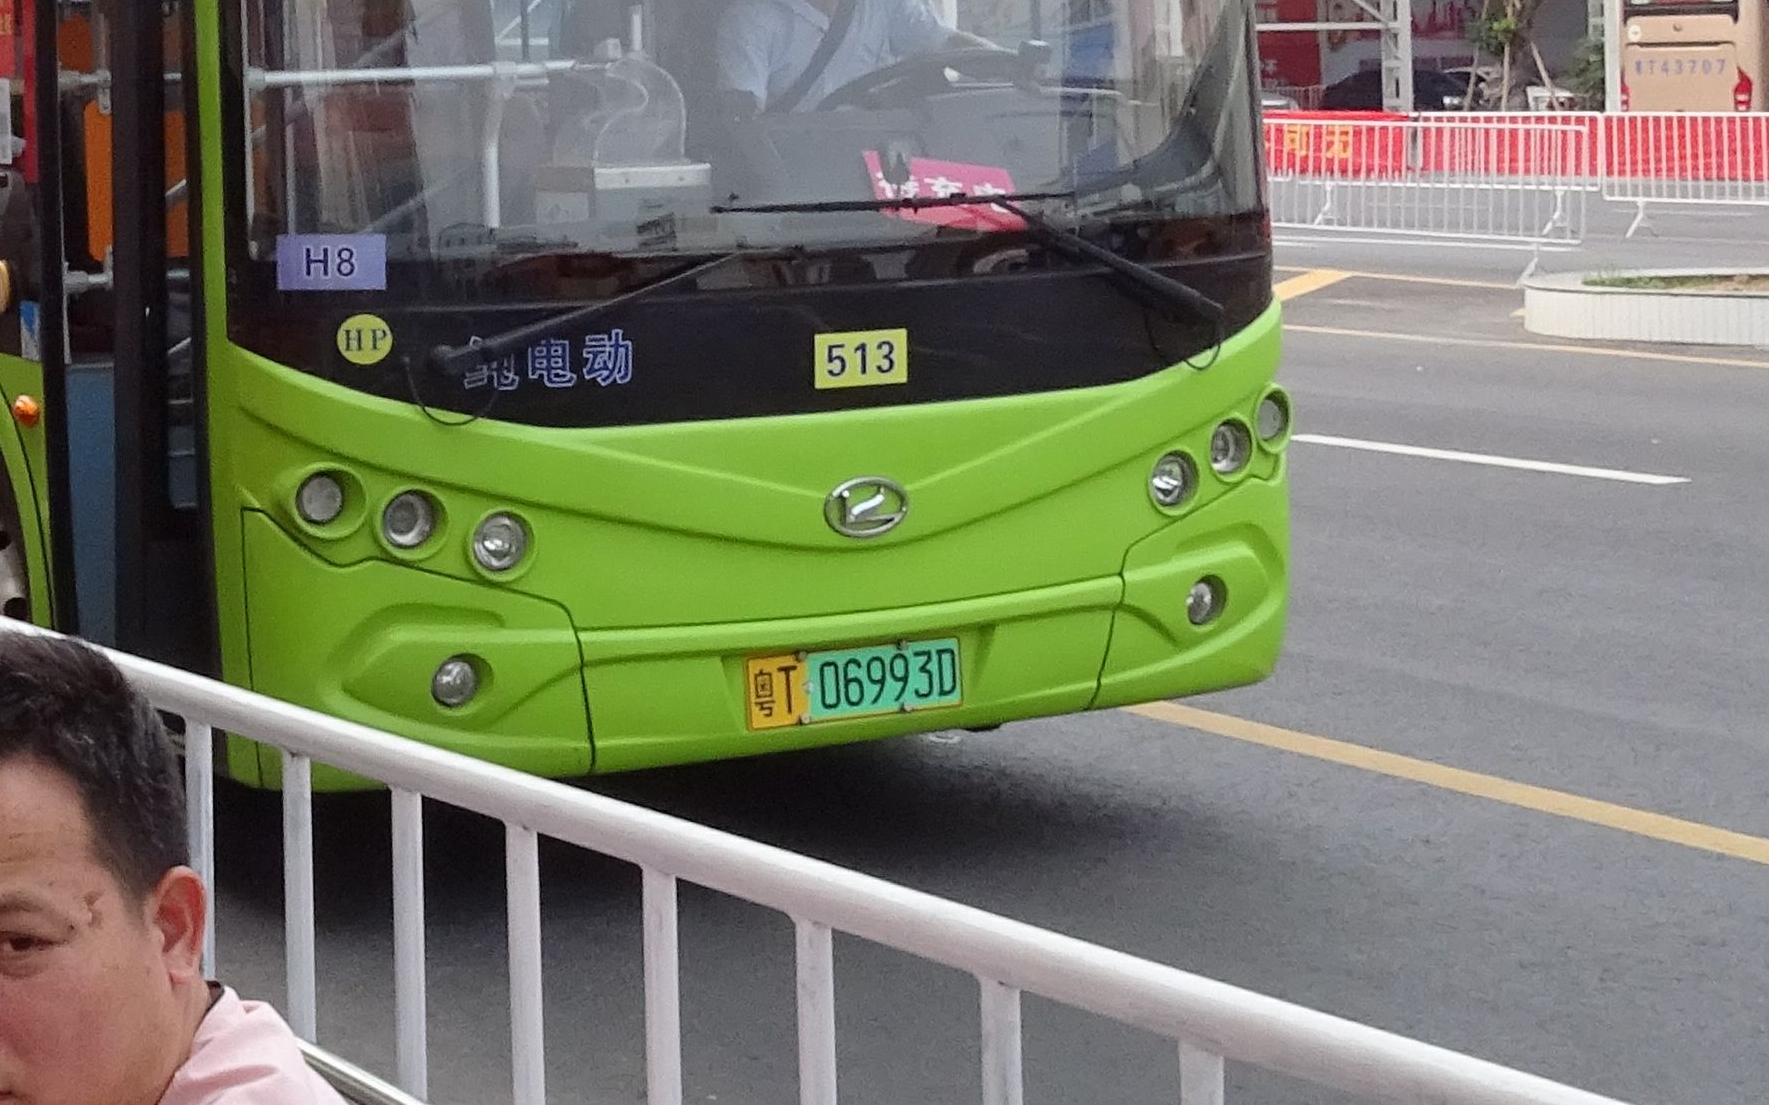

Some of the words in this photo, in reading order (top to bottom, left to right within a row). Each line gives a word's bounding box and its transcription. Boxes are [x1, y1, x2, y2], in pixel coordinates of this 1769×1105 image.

[304, 247, 356, 277] H8
[343, 327, 388, 352] HP
[825, 340, 896, 378] 513
